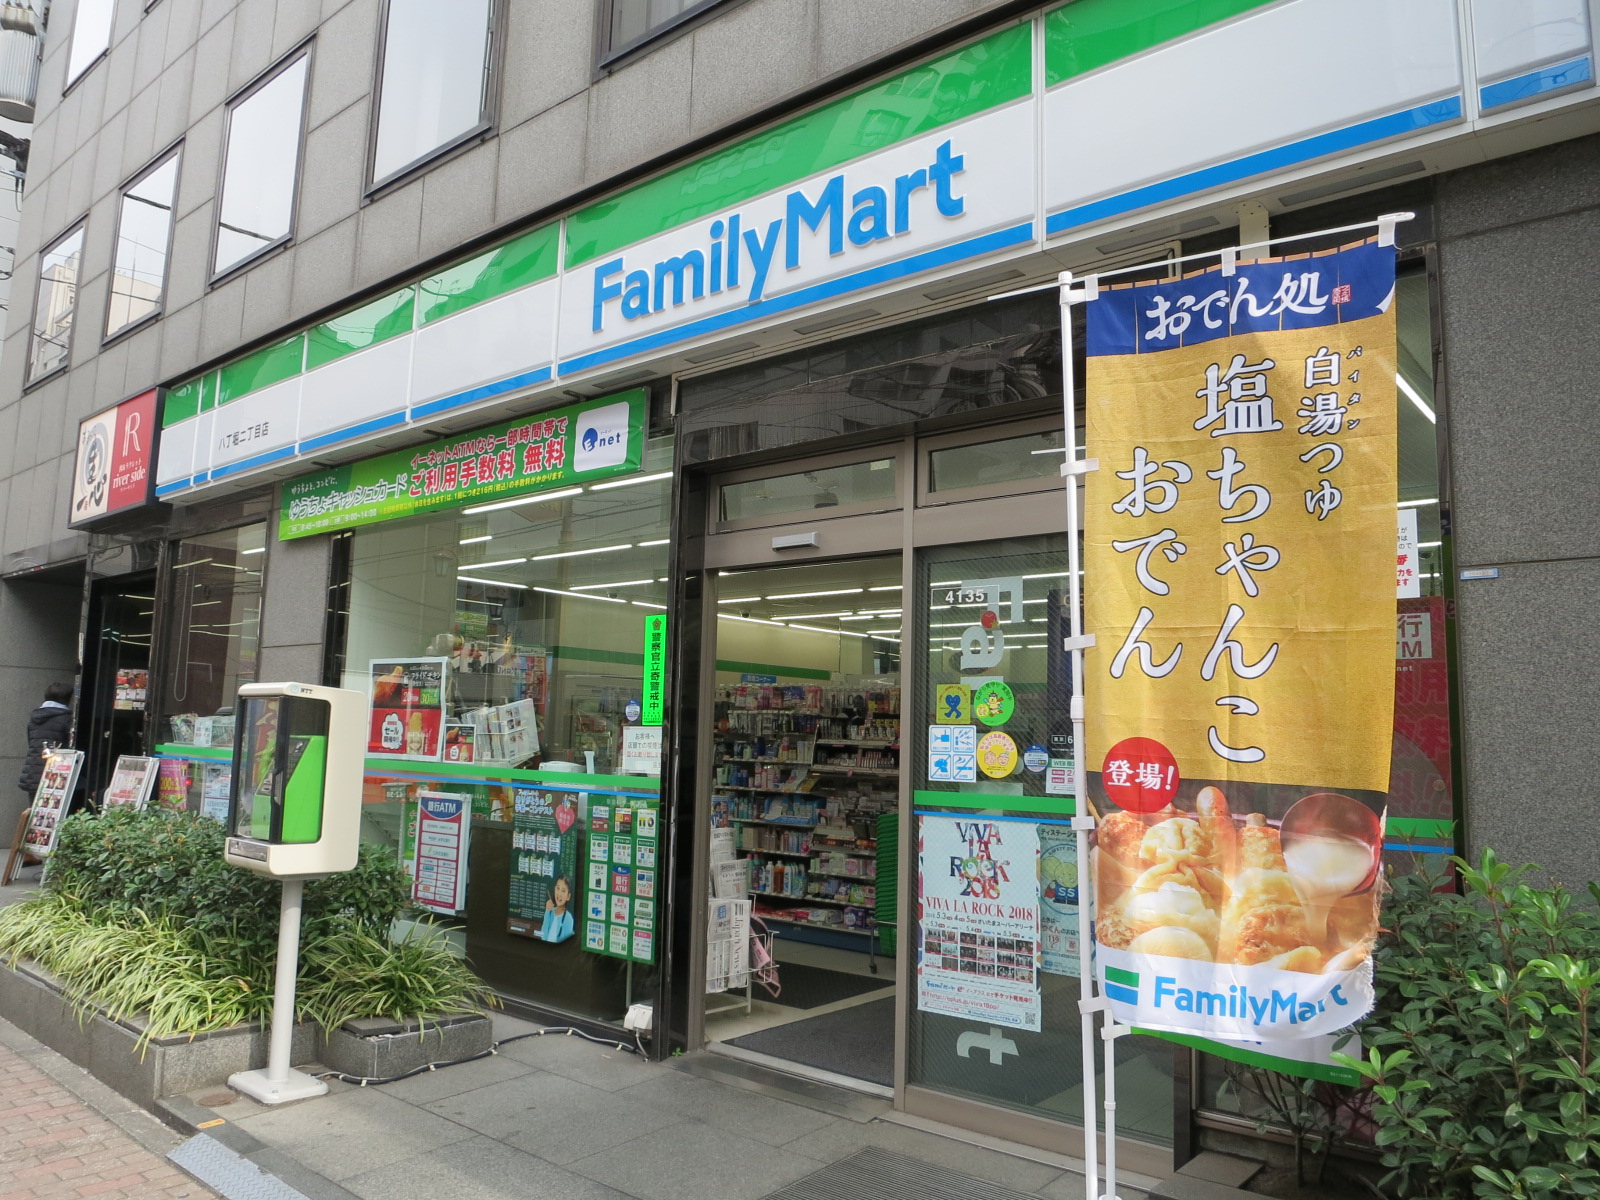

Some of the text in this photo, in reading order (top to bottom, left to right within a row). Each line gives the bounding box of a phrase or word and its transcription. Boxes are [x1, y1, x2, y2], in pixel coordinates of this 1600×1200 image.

[591, 137, 965, 333] FamilyMart
[1145, 271, 1330, 341] おでん処
[1346, 345, 1363, 430] パイタン
[122, 411, 141, 457] R
[219, 421, 269, 450] 八丁堀二丁目店
[410, 416, 569, 470] イーネットATMなら一部時間帯で
[1297, 346, 1346, 521] 白湯つゆ
[112, 465, 146, 489] river side
[408, 436, 566, 497] ご利用手数料 無料
[289, 473, 408, 521] ゆうちょキャッシュカード
[1109, 446, 1193, 679] おでん
[1193, 353, 1284, 763] 塩ちゃんこ
[945, 588, 985, 603] 4135
[649, 632, 662, 711] 警察官立寄警戒中
[300, 687, 313, 695] NTT
[384, 726, 399, 735] セール
[1105, 759, 1175, 791] 登場!
[427, 800, 457, 813] 銀行ATM
[954, 821, 1003, 846] VIVA
[615, 885, 627, 893] ATM
[960, 875, 1001, 900] 2018
[1058, 887, 1075, 897] SS
[926, 896, 1033, 921] VIVA LA ROCK 2018
[731, 916, 744, 943] Japan
